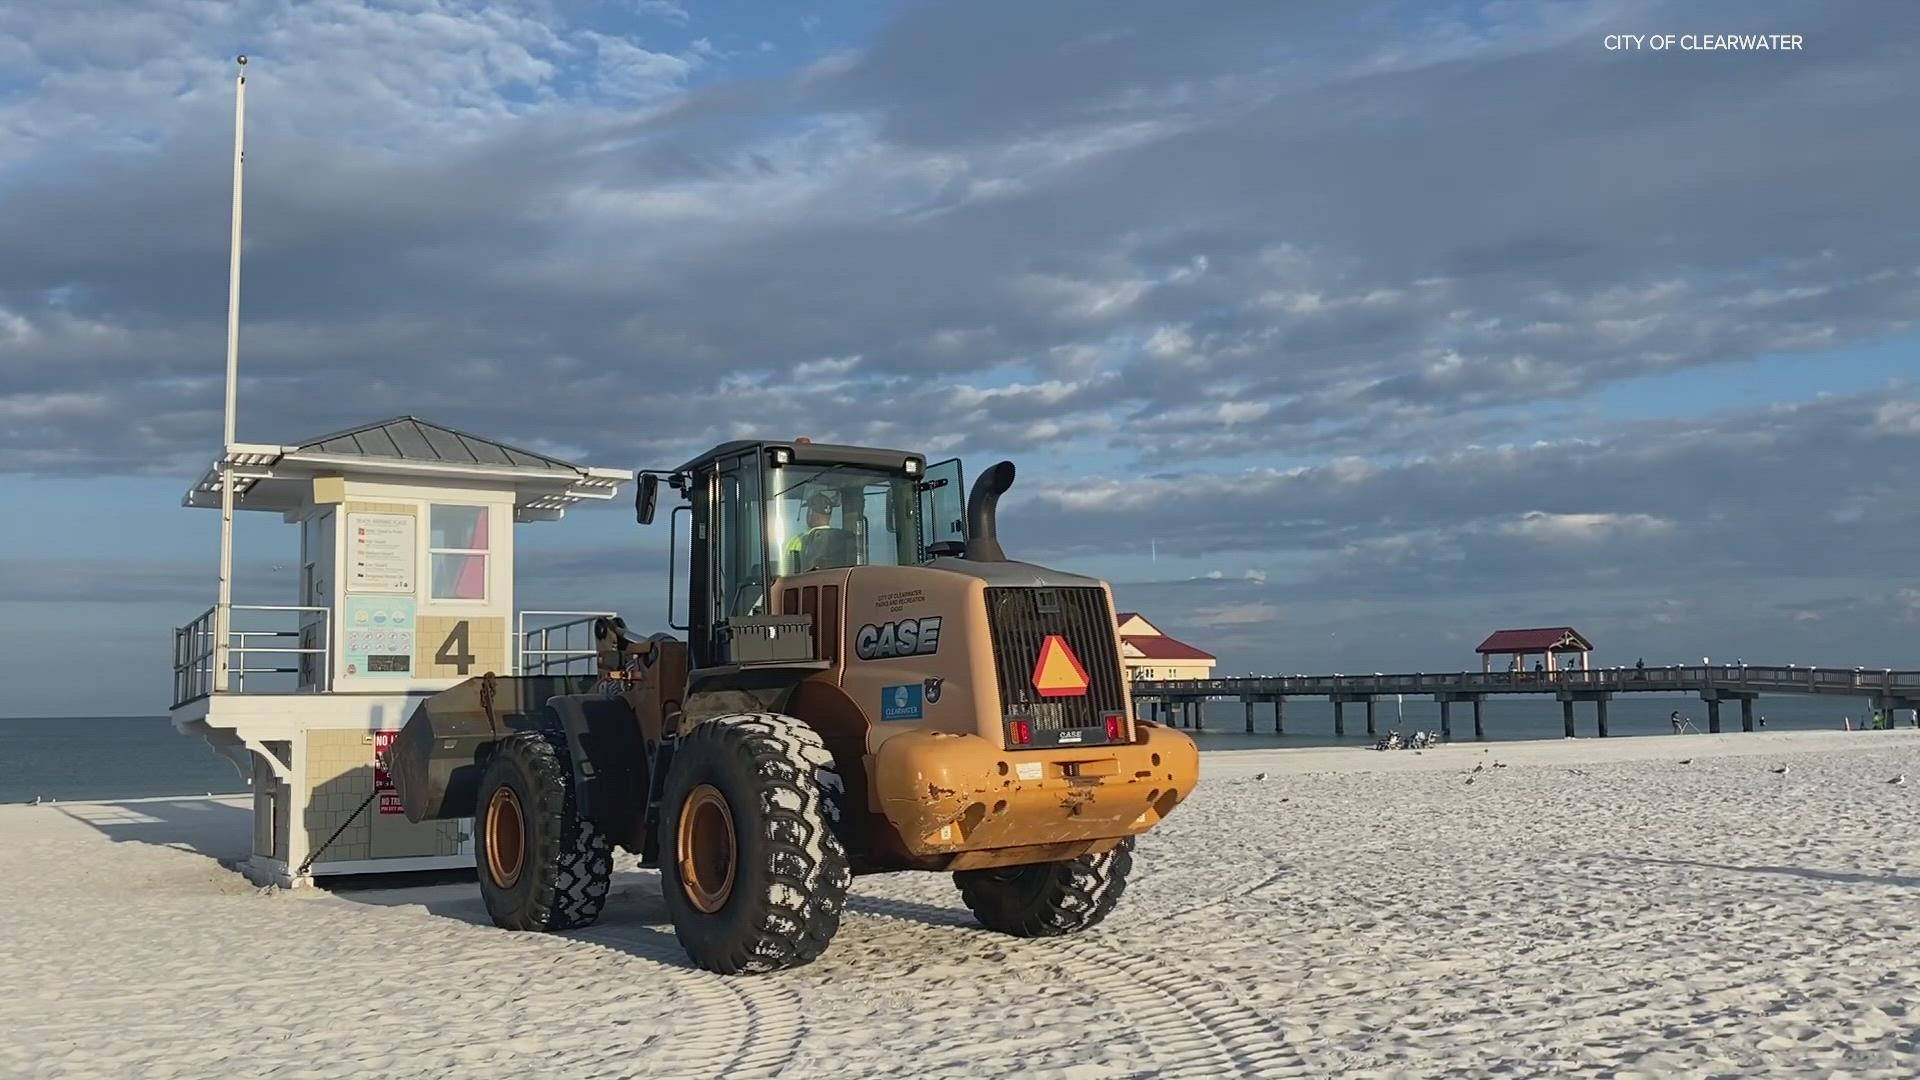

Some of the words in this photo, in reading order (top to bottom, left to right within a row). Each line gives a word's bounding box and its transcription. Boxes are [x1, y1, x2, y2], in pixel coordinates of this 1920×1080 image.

[894, 590, 922, 599] CLEARWATER
[899, 596, 925, 604] RECREATION
[856, 616, 942, 660] CASE
[435, 621, 475, 675] 4
[886, 707, 918, 715] CLEARWATER
[377, 735, 388, 746] NO
[381, 797, 390, 805] NO
